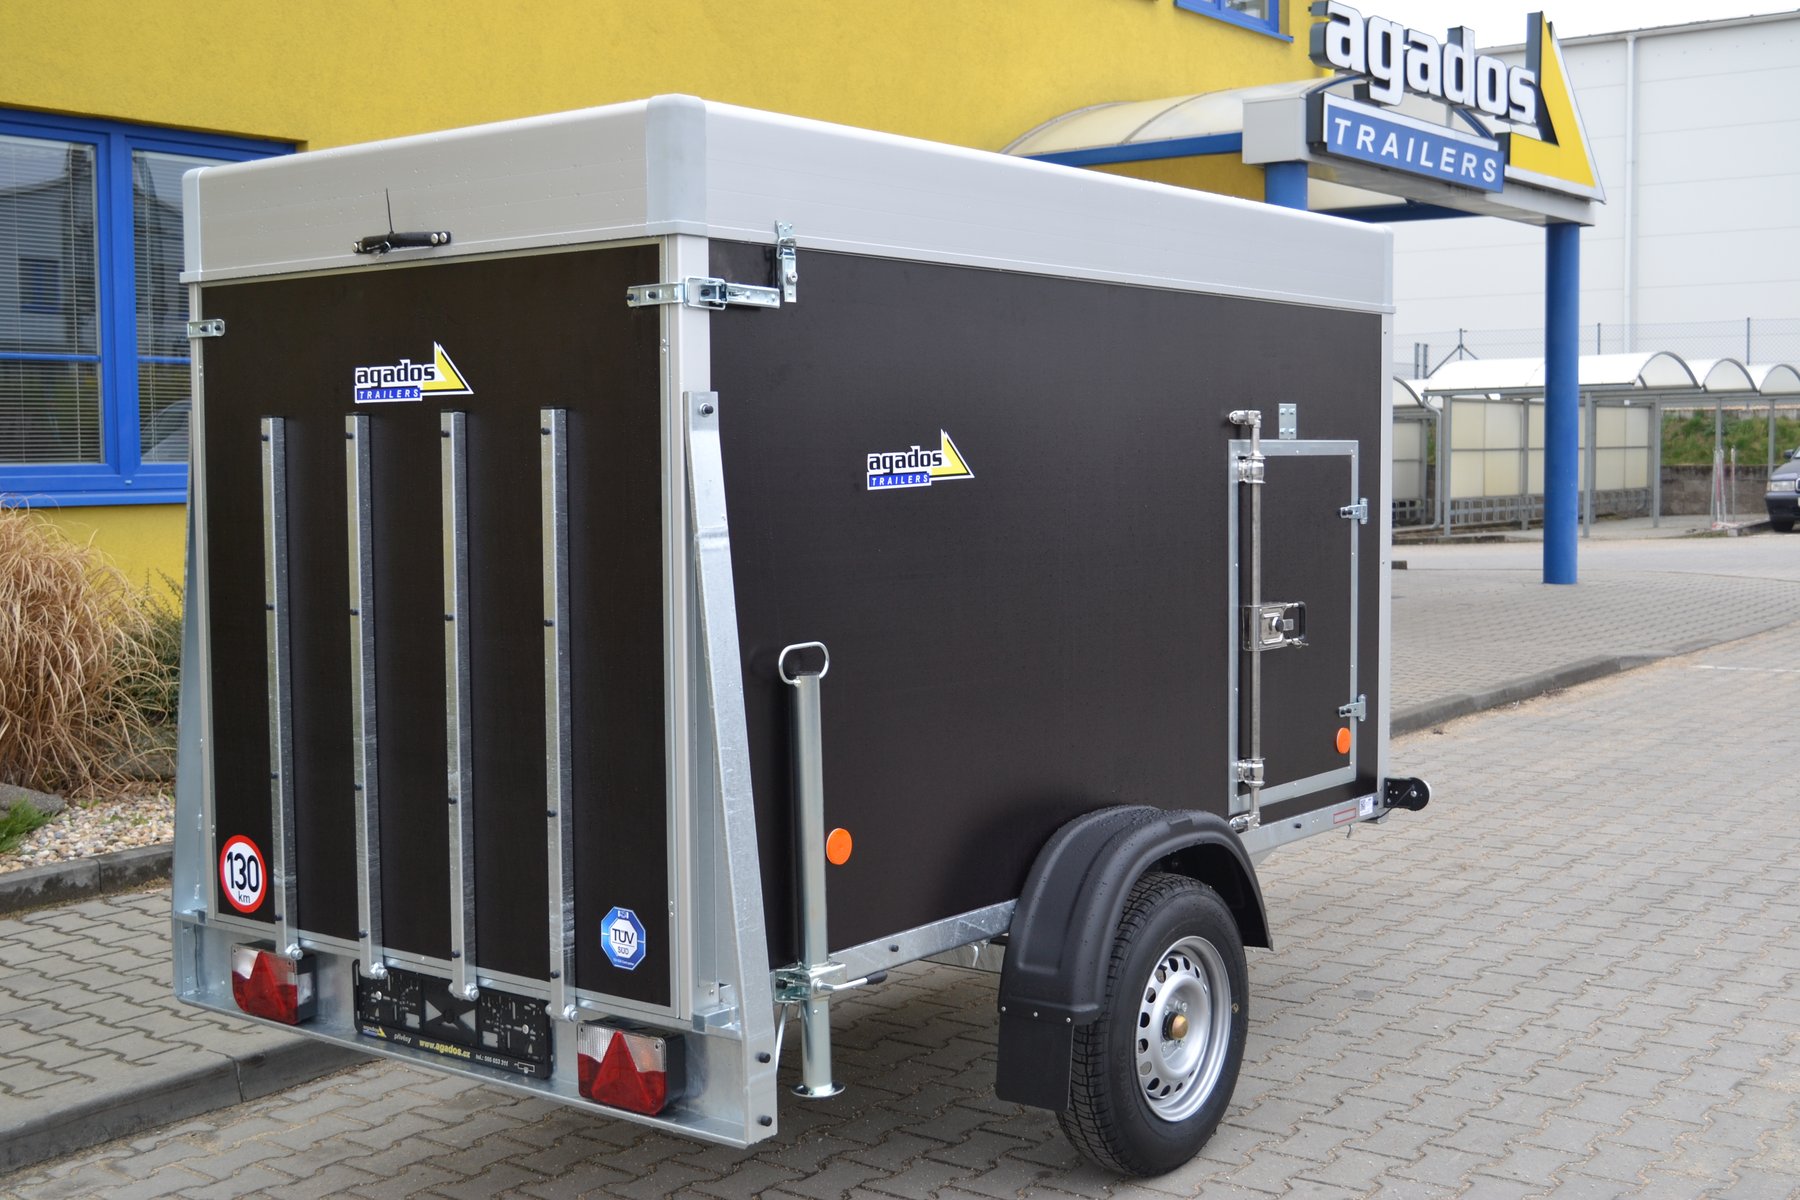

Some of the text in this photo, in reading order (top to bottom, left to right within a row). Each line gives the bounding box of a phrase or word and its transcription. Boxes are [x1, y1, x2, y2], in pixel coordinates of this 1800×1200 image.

[1322, 0, 1537, 125] agados
[1334, 117, 1498, 184] TRAILERS
[356, 361, 436, 387] agados
[359, 388, 420, 400] TRAILERS
[868, 447, 943, 474] agados
[872, 474, 929, 487] TRAILERS
[226, 851, 261, 893] 130
[237, 890, 251, 904] km
[419, 1039, 471, 1059] www.agados.cz
